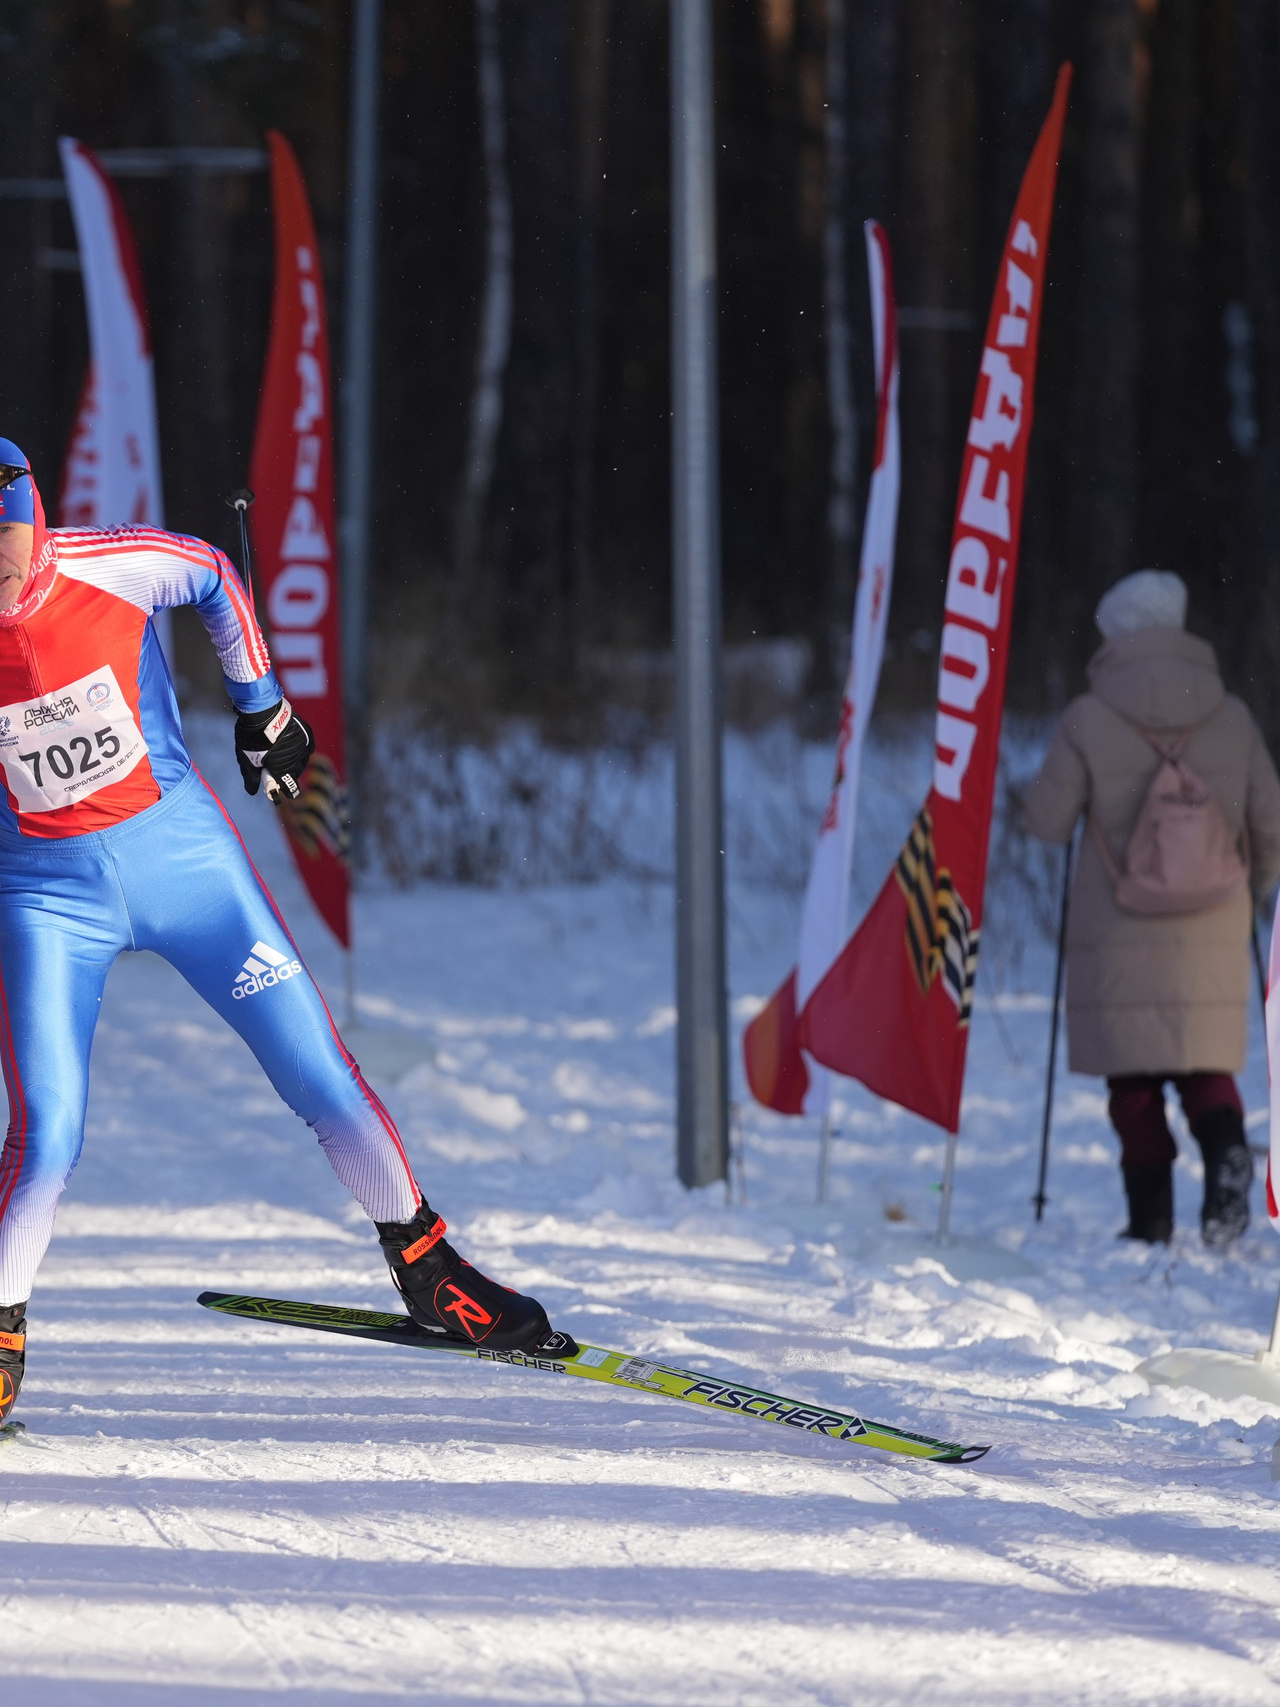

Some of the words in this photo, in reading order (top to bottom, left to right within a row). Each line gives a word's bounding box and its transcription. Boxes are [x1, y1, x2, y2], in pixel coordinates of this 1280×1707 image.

[23, 696, 74, 720] ЛЫЖНЯ
[23, 704, 81, 730] РОССИИ
[19, 726, 121, 787] 7025
[231, 960, 302, 1000] adidas
[476, 1348, 568, 1374] FISCHER
[682, 1380, 845, 1437] FISCHER
